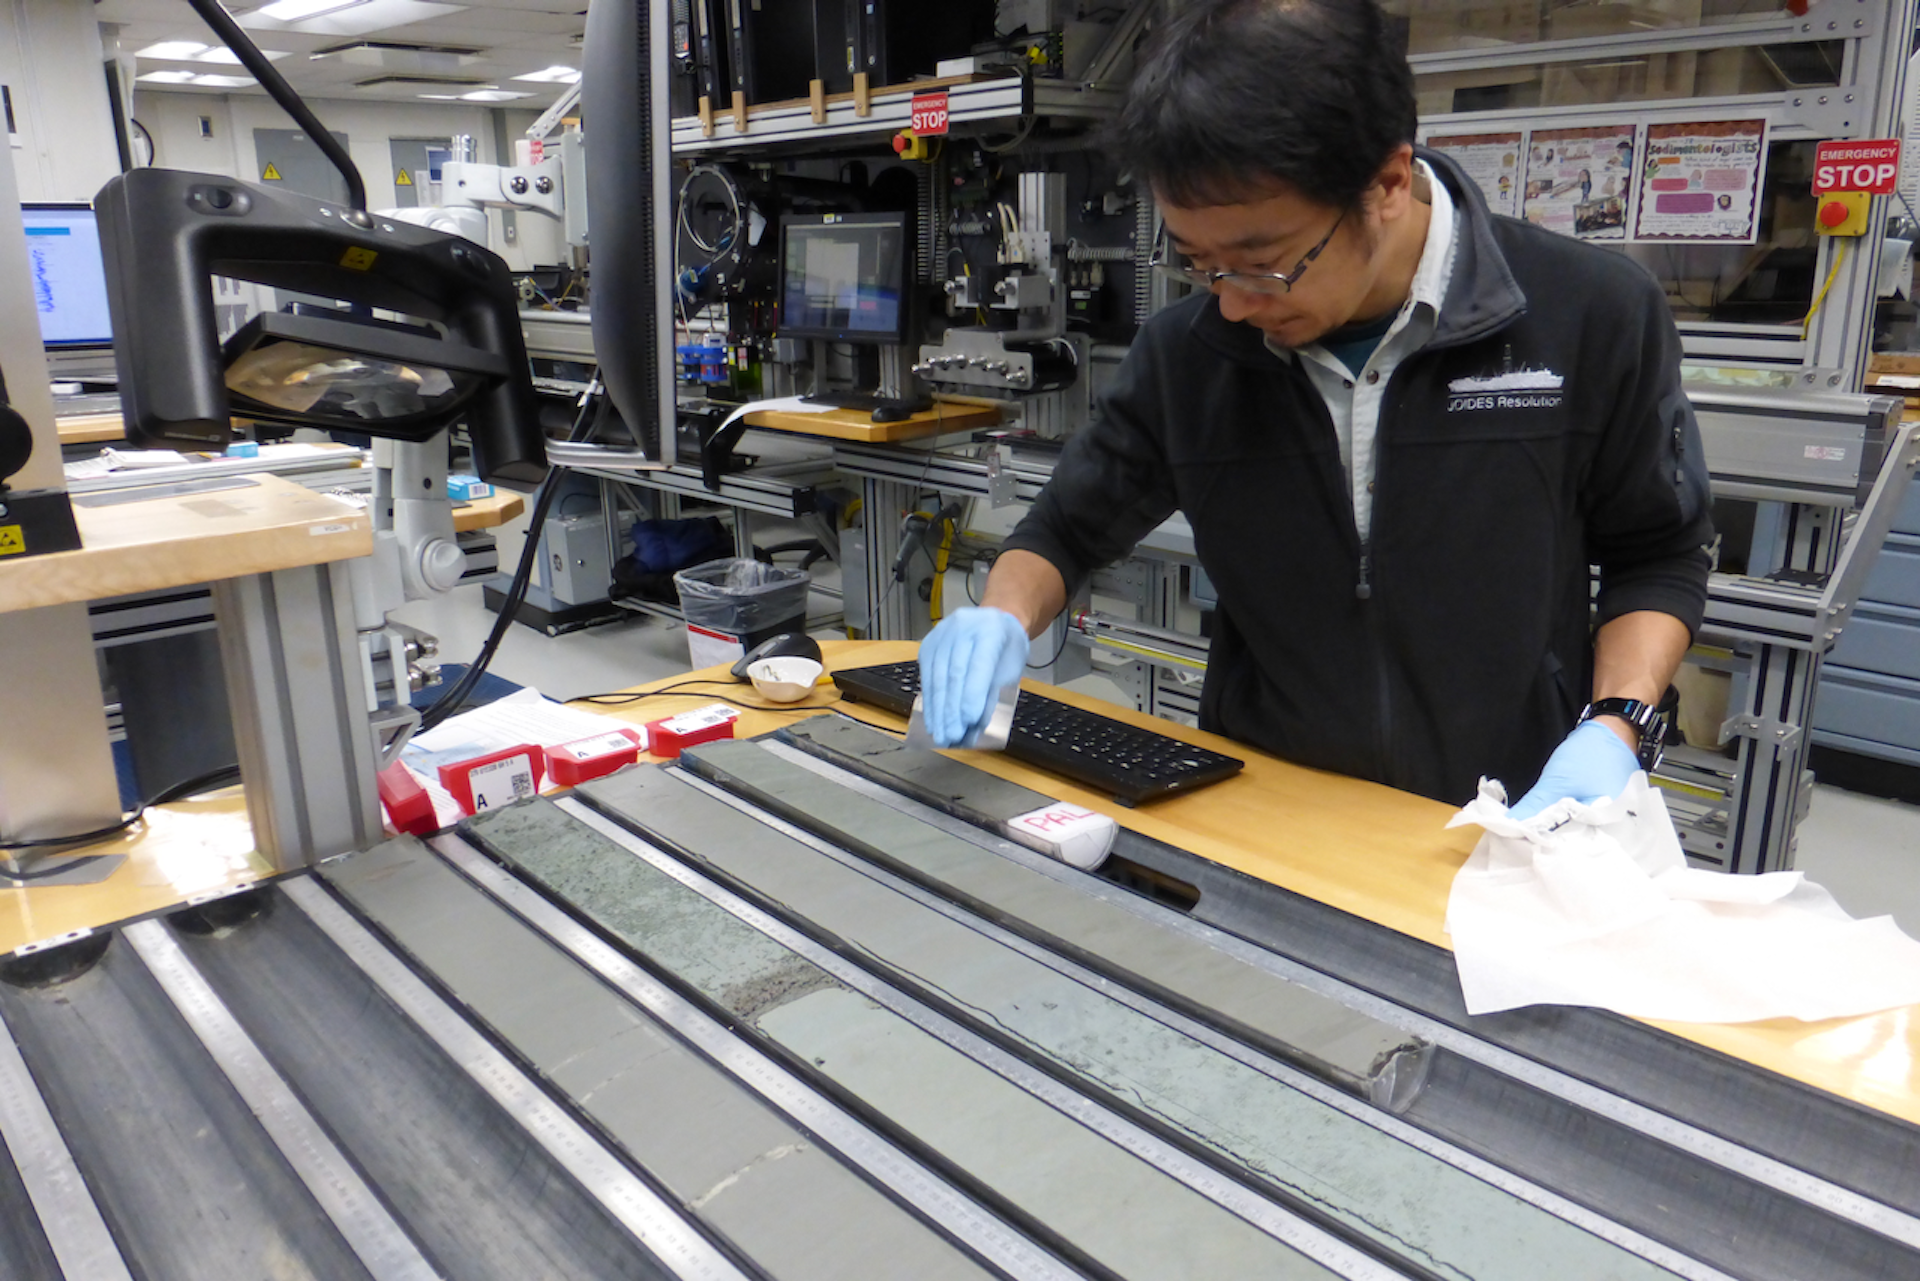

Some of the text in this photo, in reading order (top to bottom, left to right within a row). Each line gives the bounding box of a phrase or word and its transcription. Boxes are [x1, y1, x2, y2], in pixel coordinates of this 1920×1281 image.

[914, 100, 946, 109] EMERGENCY
[913, 111, 947, 130] STOP
[1820, 148, 1897, 160] EMERGENCY
[1816, 164, 1895, 188] STOP
[1447, 395, 1563, 412] JOIDES Resolution
[477, 793, 488, 810] A
[1023, 808, 1097, 832] PAL
